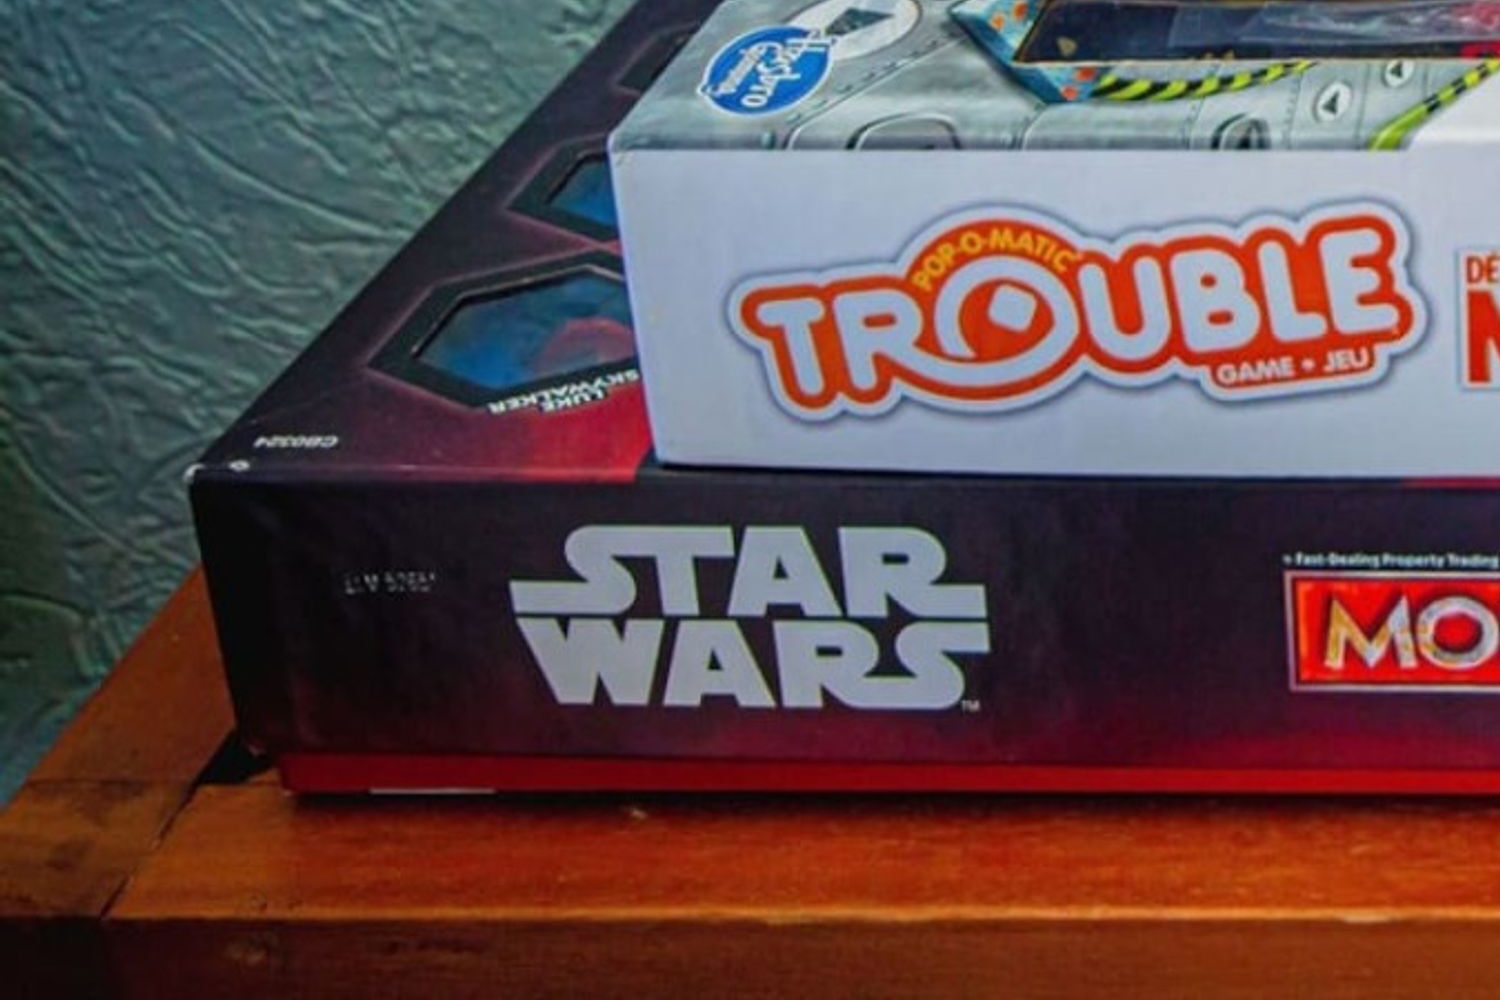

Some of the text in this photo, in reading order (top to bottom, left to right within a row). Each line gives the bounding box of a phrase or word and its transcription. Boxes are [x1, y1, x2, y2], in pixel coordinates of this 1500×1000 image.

[911, 227, 1076, 292] POP-O-MATIC
[756, 229, 1400, 397] TROUBLE
[487, 368, 640, 414] SKYWALKER
[1216, 347, 1370, 384] GAME JEU
[539, 388, 608, 412] LUKE
[509, 525, 988, 618] STAR
[517, 618, 991, 710] WARS
